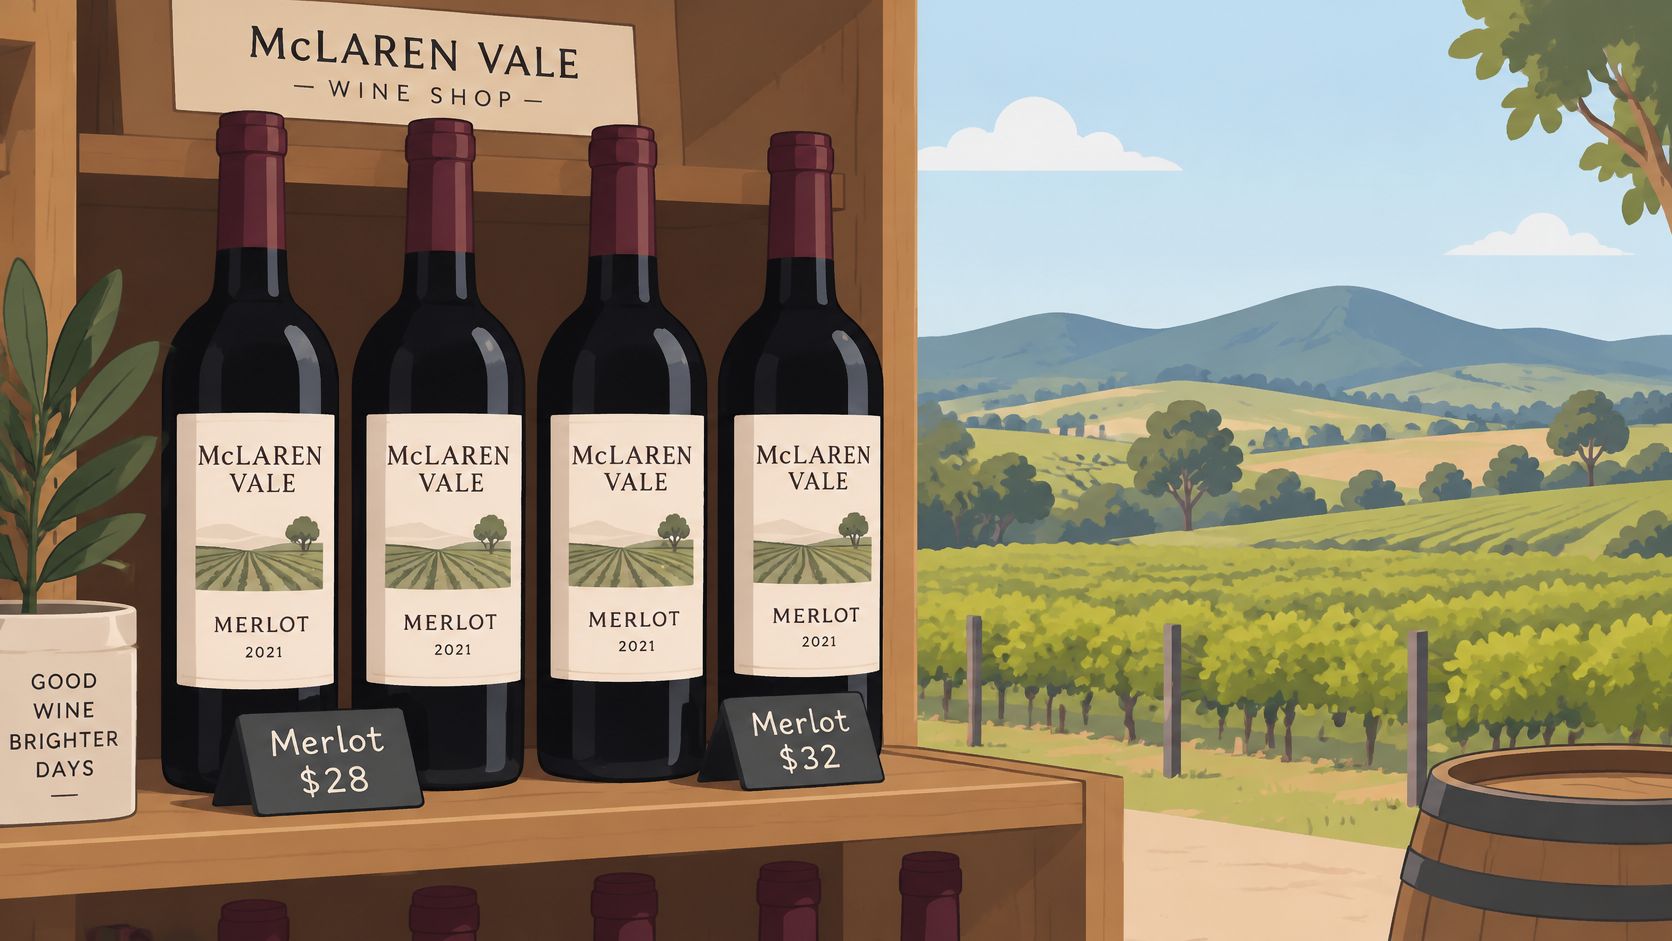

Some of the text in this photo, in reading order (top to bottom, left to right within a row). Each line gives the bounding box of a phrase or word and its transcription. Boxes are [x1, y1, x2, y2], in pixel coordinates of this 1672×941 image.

[250, 25, 579, 80] McLAREN VALE
[328, 79, 511, 108] WINE SHOP
[198, 445, 322, 466] McLAREN
[387, 445, 510, 466] McLAREN
[572, 444, 692, 465] McLAREN
[756, 444, 871, 465] McLAREN
[229, 472, 296, 493] VALE
[418, 472, 484, 493] VALE
[603, 472, 668, 492] VALE
[787, 471, 848, 491] VALE
[214, 615, 309, 633] MERLOT
[403, 613, 497, 631] MERLOT
[588, 610, 680, 628] MERLOT
[773, 606, 860, 624] MERLOT
[434, 643, 471, 656] 2021
[618, 640, 655, 652] 2021
[801, 635, 836, 648] 2021
[245, 646, 282, 659] 2021
[31, 672, 97, 691] GOOD
[33, 701, 94, 720] WINE
[751, 707, 850, 737] Merlot
[9, 730, 118, 751] BRIGHTER
[271, 725, 385, 757] Merlot
[36, 759, 94, 778] DAYS
[779, 743, 841, 775] $32
[300, 764, 369, 798] $28
